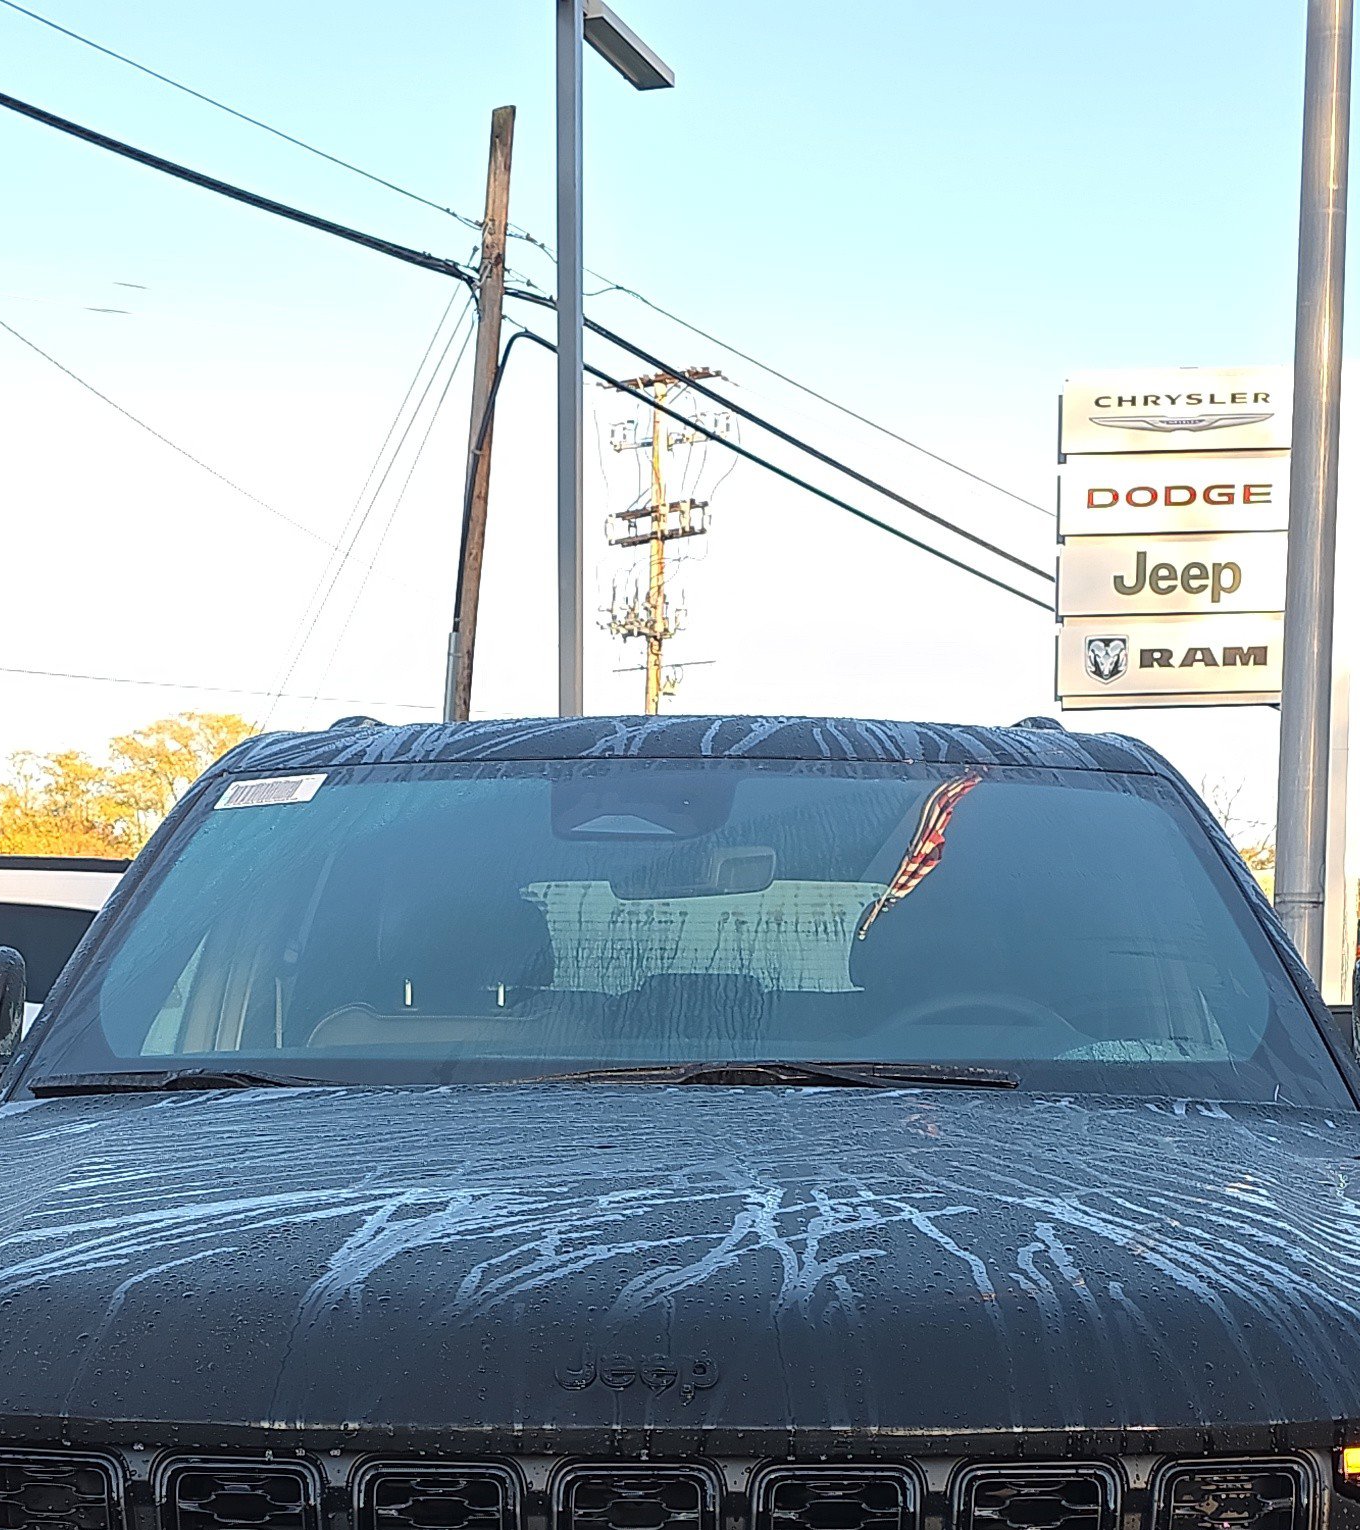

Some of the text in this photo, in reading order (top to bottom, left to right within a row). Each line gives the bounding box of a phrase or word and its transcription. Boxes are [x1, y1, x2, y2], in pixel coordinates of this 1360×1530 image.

[1093, 391, 1271, 409] CHRYSLER
[1086, 483, 1273, 509] DODGE
[1112, 550, 1242, 604] Jeep
[1138, 645, 1269, 669] RAM
[554, 1344, 720, 1402] Jeep
